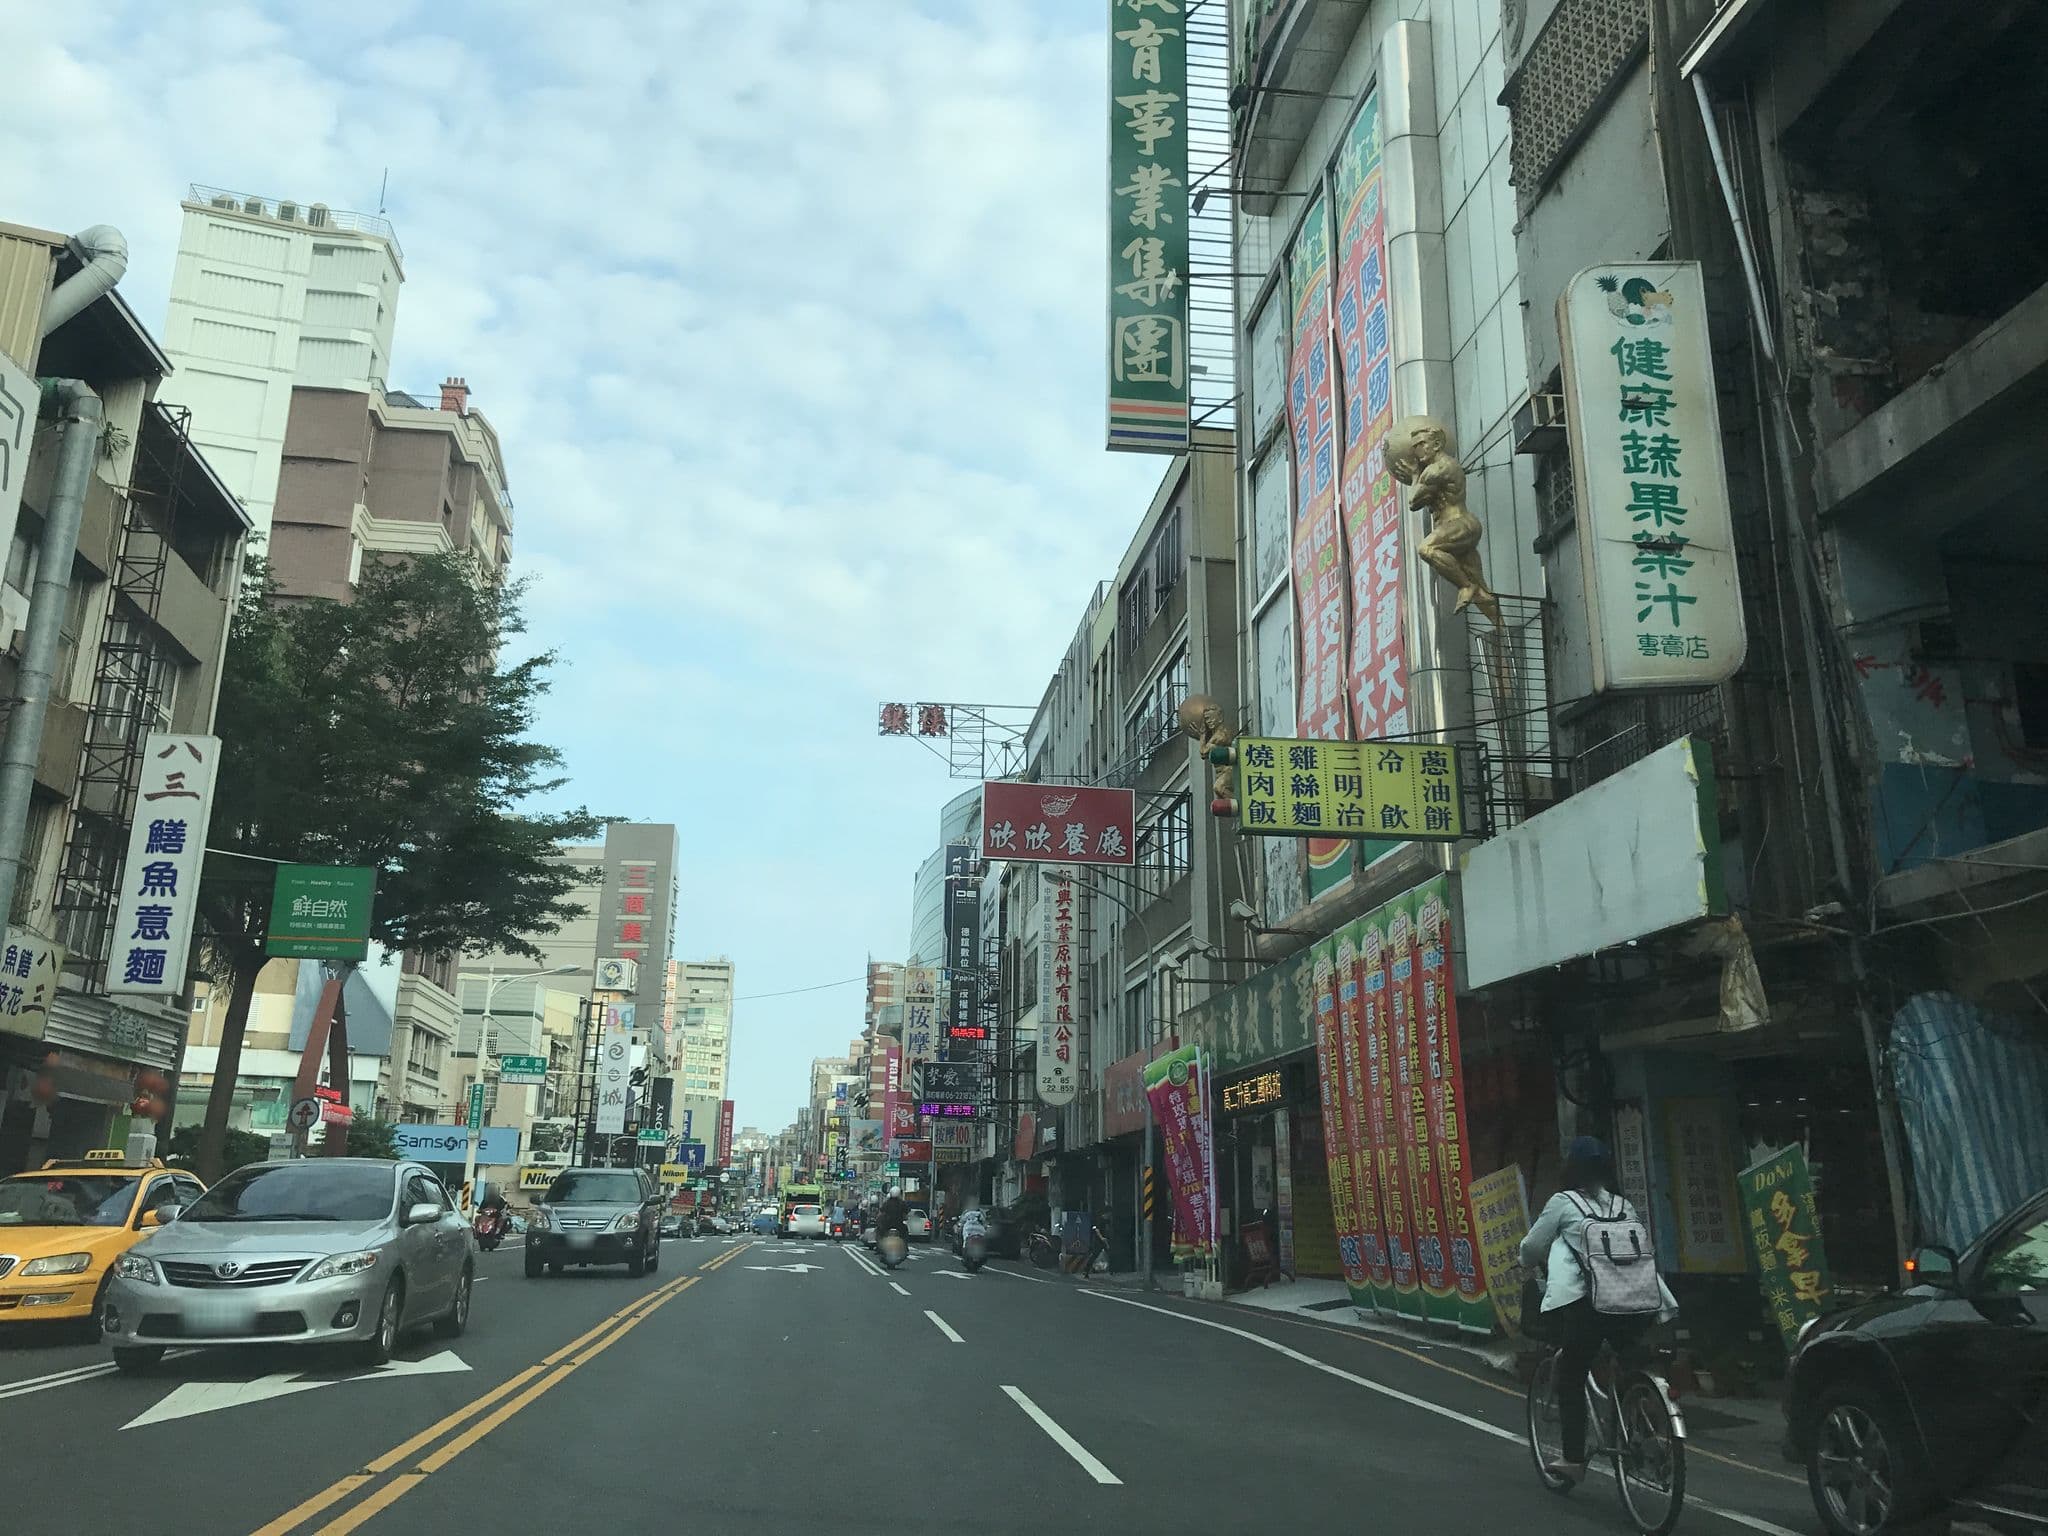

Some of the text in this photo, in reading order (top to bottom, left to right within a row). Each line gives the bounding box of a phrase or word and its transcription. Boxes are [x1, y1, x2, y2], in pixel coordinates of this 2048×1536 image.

[1113, 0, 1183, 389] 育事業集團
[1612, 335, 1699, 628] 健康蔬果菜汁
[1636, 633, 1711, 660] 專賣店
[144, 738, 205, 802] 八三
[1245, 743, 1277, 825] 燒肉飯
[1288, 745, 1321, 827] 雞絲麵
[1333, 747, 1365, 828] 三明治
[1377, 748, 1410, 830] 冷飲
[1419, 750, 1453, 832] 蔥油餅
[988, 820, 1129, 859] 欣欣餐廳
[122, 818, 190, 986] 鱔魚意麵
[291, 895, 348, 918] 鮮自然
[908, 1005, 931, 1055] 按摩
[654, 1104, 666, 1131] ONY
[524, 1172, 557, 1186] Niko
[662, 1168, 686, 1178] Nikon
